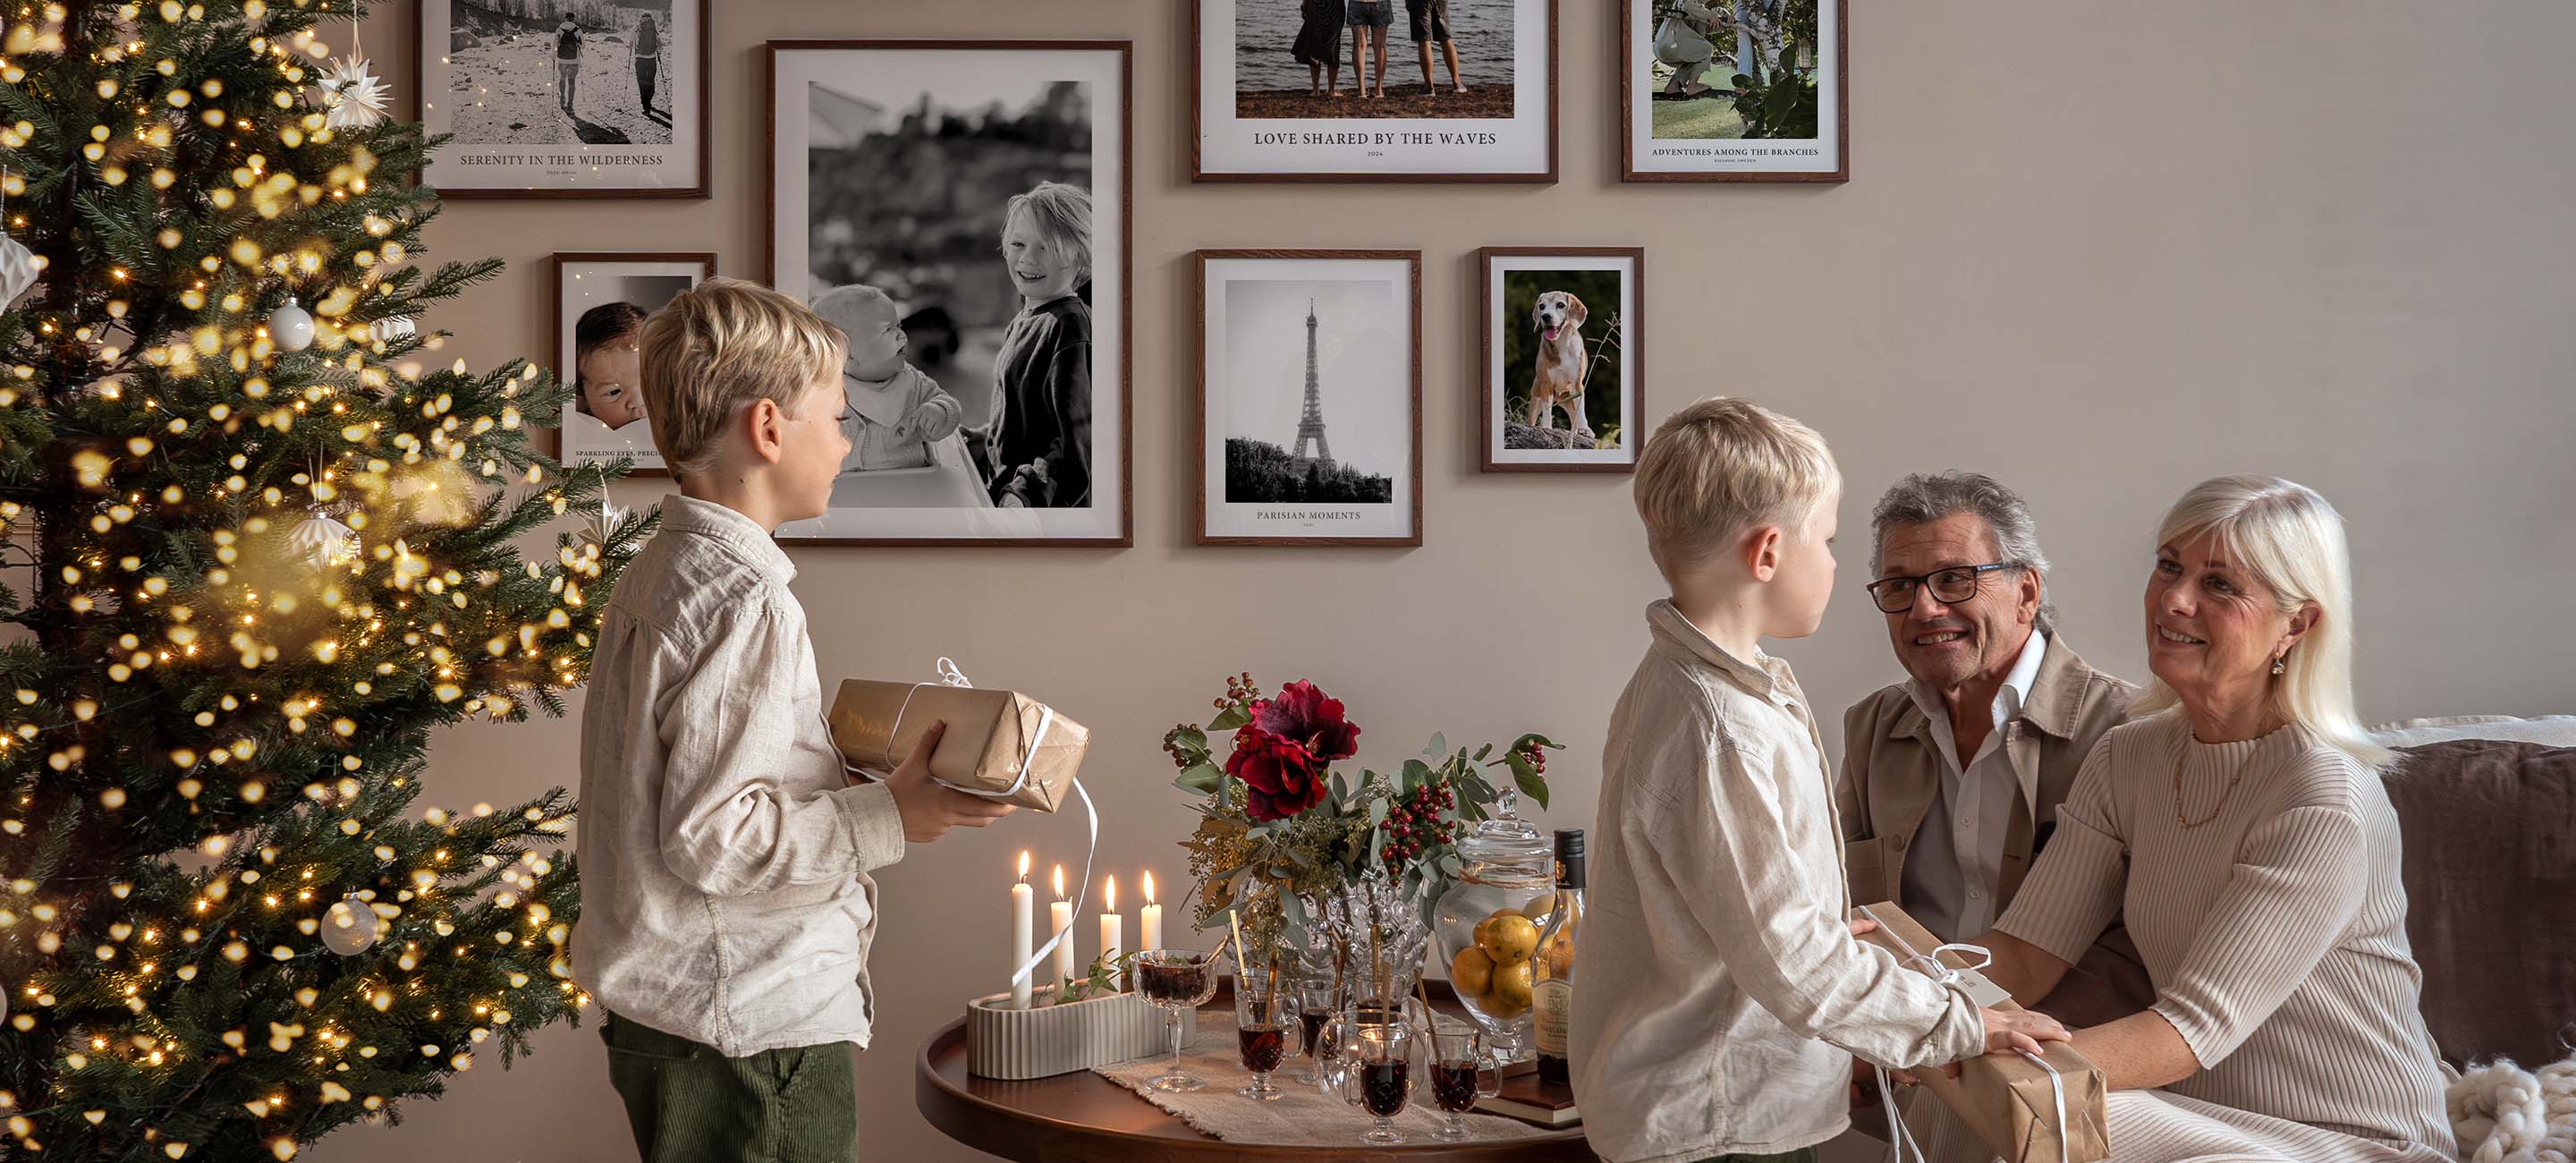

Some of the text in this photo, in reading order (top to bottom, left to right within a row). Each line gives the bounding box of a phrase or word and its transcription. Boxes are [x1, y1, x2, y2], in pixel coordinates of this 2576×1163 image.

[1254, 132, 1496, 145] LOVE SHARED BY THE WAVES
[1652, 149, 1818, 157] ADVENTURES AMONG THE BRANCHES
[460, 155, 663, 166] SERENITY IN THE WILDERNESS
[1257, 511, 1360, 520] PARISIAN MOMENTS
